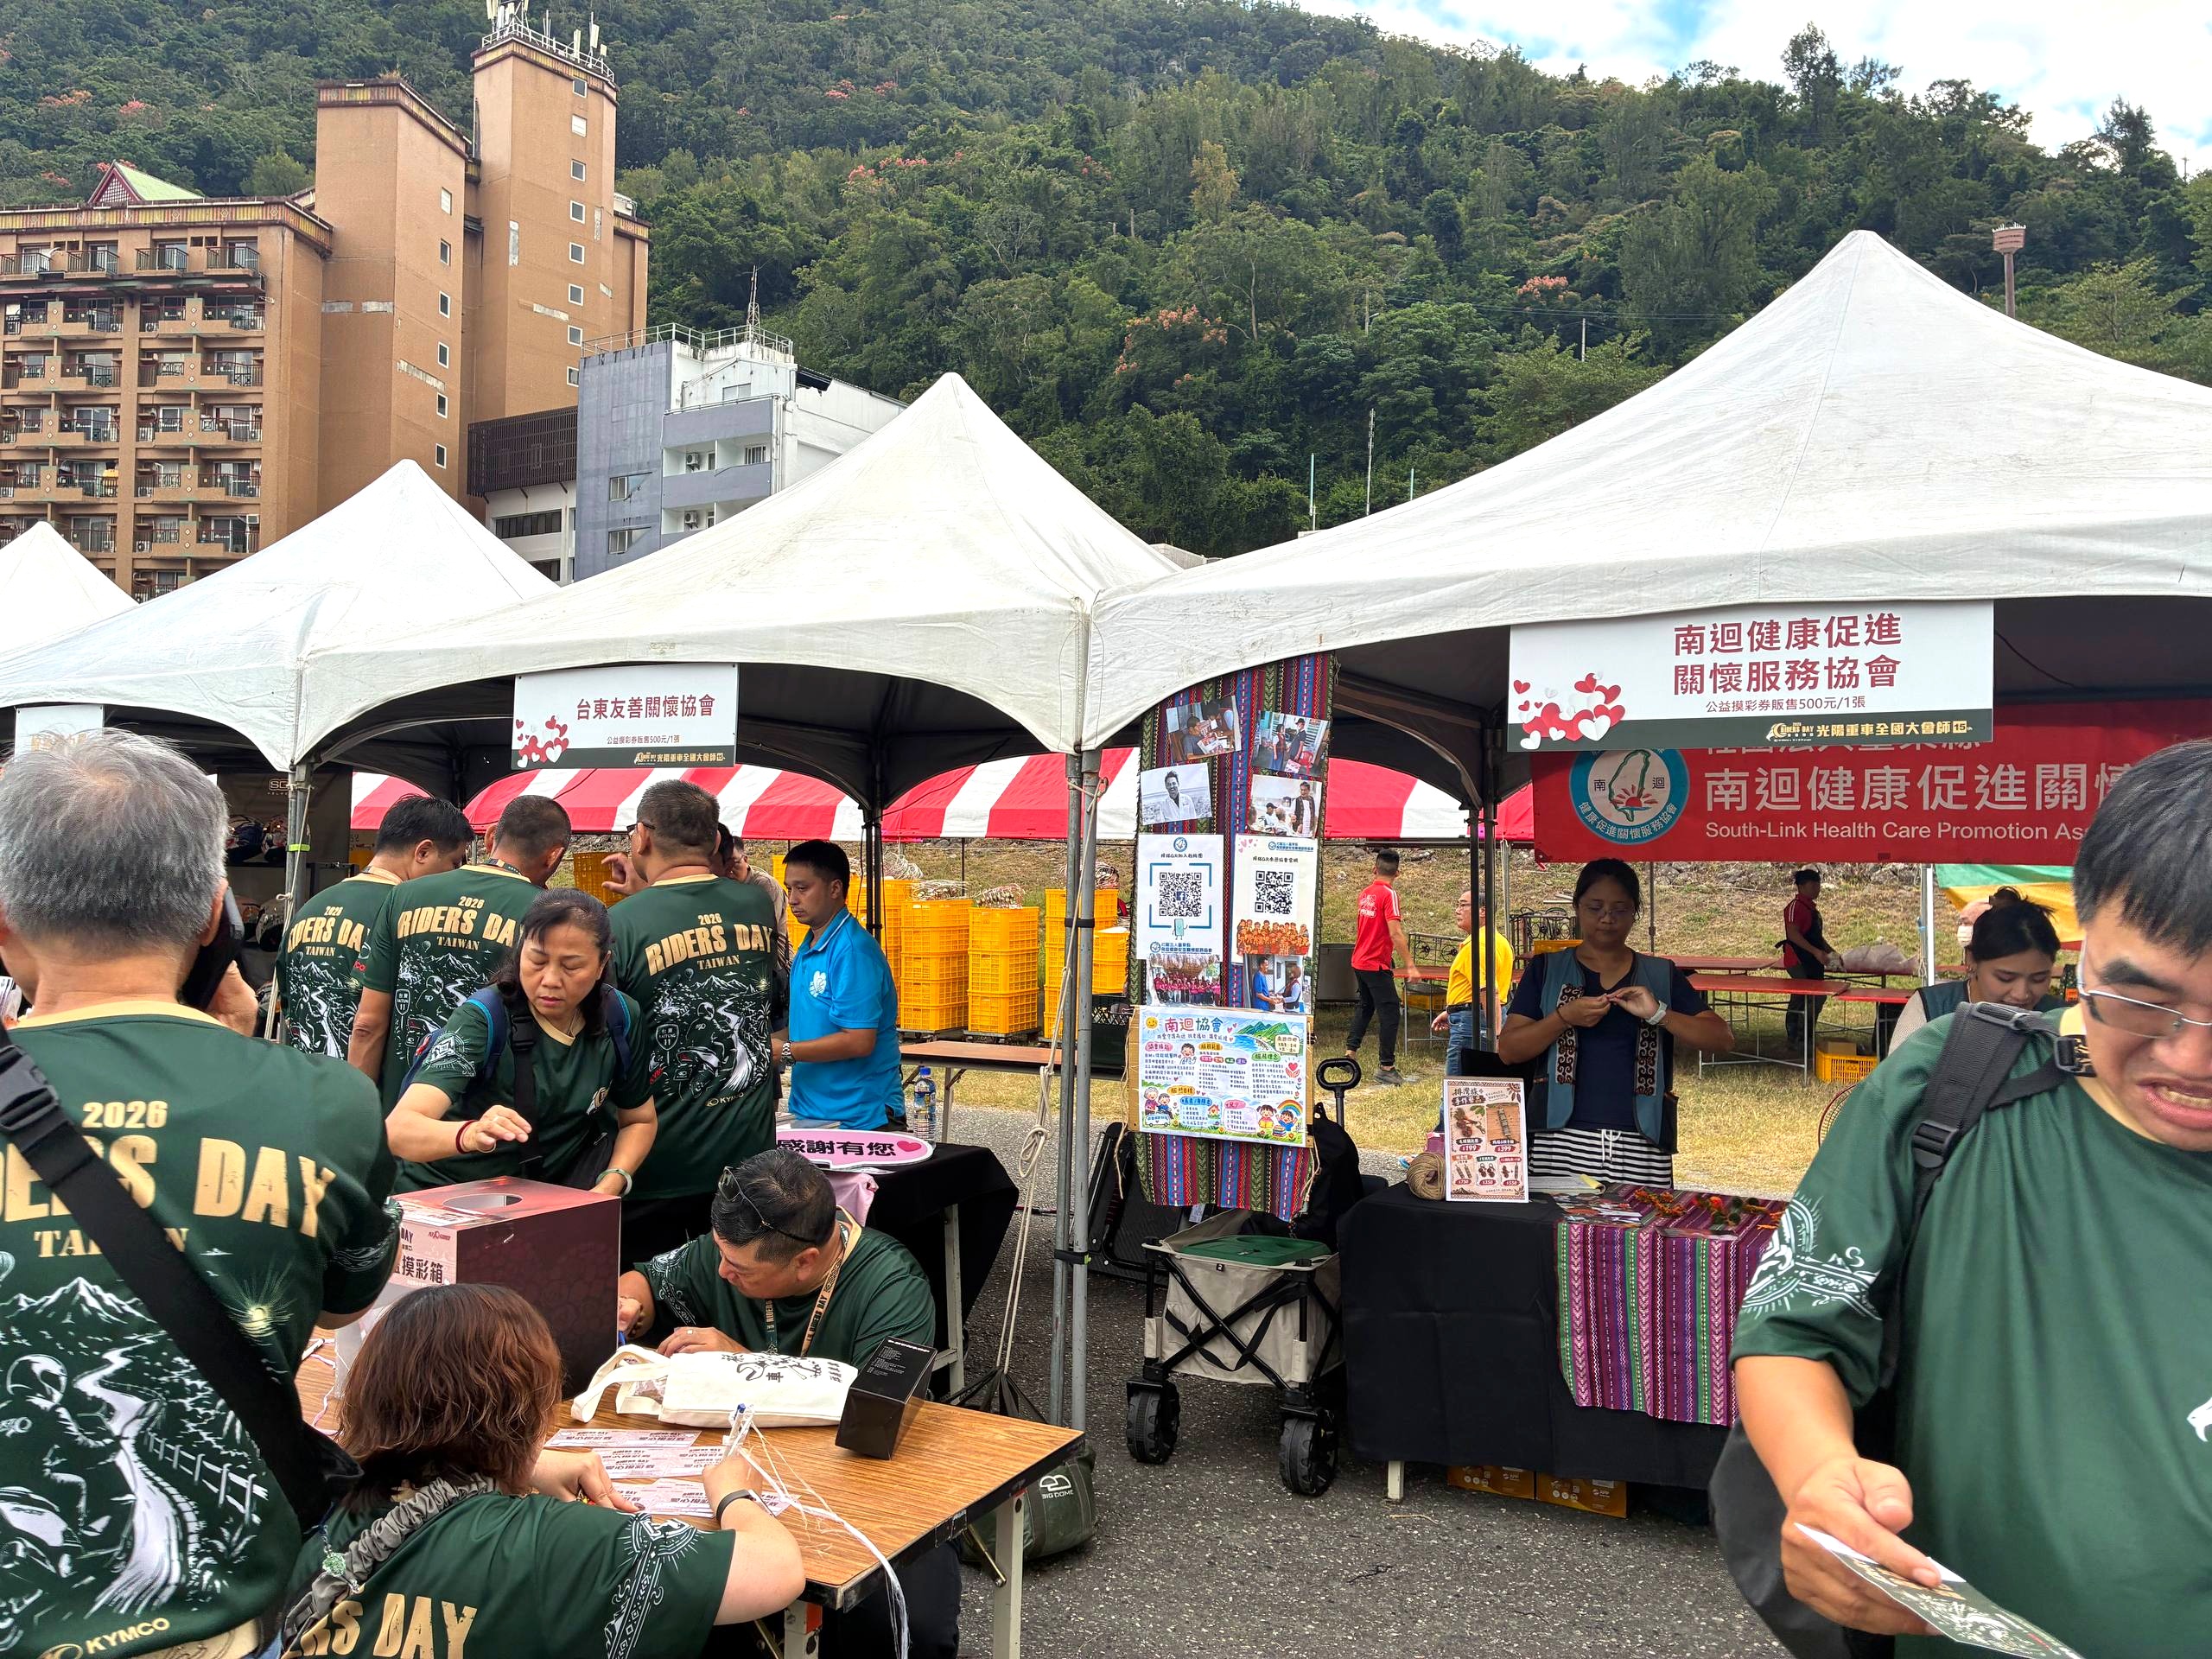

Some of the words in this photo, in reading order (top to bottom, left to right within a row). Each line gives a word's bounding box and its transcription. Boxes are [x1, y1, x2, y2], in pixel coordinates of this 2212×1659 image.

[1675, 613, 1902, 656] 南迴健康促進
[1674, 654, 1901, 695] 關懷服務協會
[576, 694, 715, 720] 台東友善關懷協會
[1706, 696, 1866, 713] 公益摸彩券販售500元/1張
[1816, 721, 1950, 737] 光陽重車全國大會師
[1593, 779, 1606, 791] 南
[1706, 823, 1806, 838] South-Link
[1813, 822, 1876, 838] Health
[1883, 823, 1931, 838] Care
[1937, 823, 2048, 839] Promotion
[2055, 823, 2088, 840] As
[457, 896, 485, 909] 2026
[397, 906, 478, 939] RIDERS
[482, 912, 524, 948] DA
[698, 912, 722, 925] 2026
[337, 918, 365, 953] DA
[437, 936, 480, 950] TAIWAN
[305, 946, 335, 957] TAIWAN
[645, 925, 727, 976] RIDERS
[733, 924, 773, 953] DAY
[696, 955, 741, 970] TAIWAN
[1165, 1017, 1224, 1033] 南迴協會
[82, 1100, 168, 1128] 2026
[777, 1139, 896, 1156] 感謝有您
[194, 1136, 337, 1238] DAY
[401, 1227, 414, 1244] DAY
[373, 1592, 478, 1659] DAY
[86, 1618, 170, 1655] KYMCO
